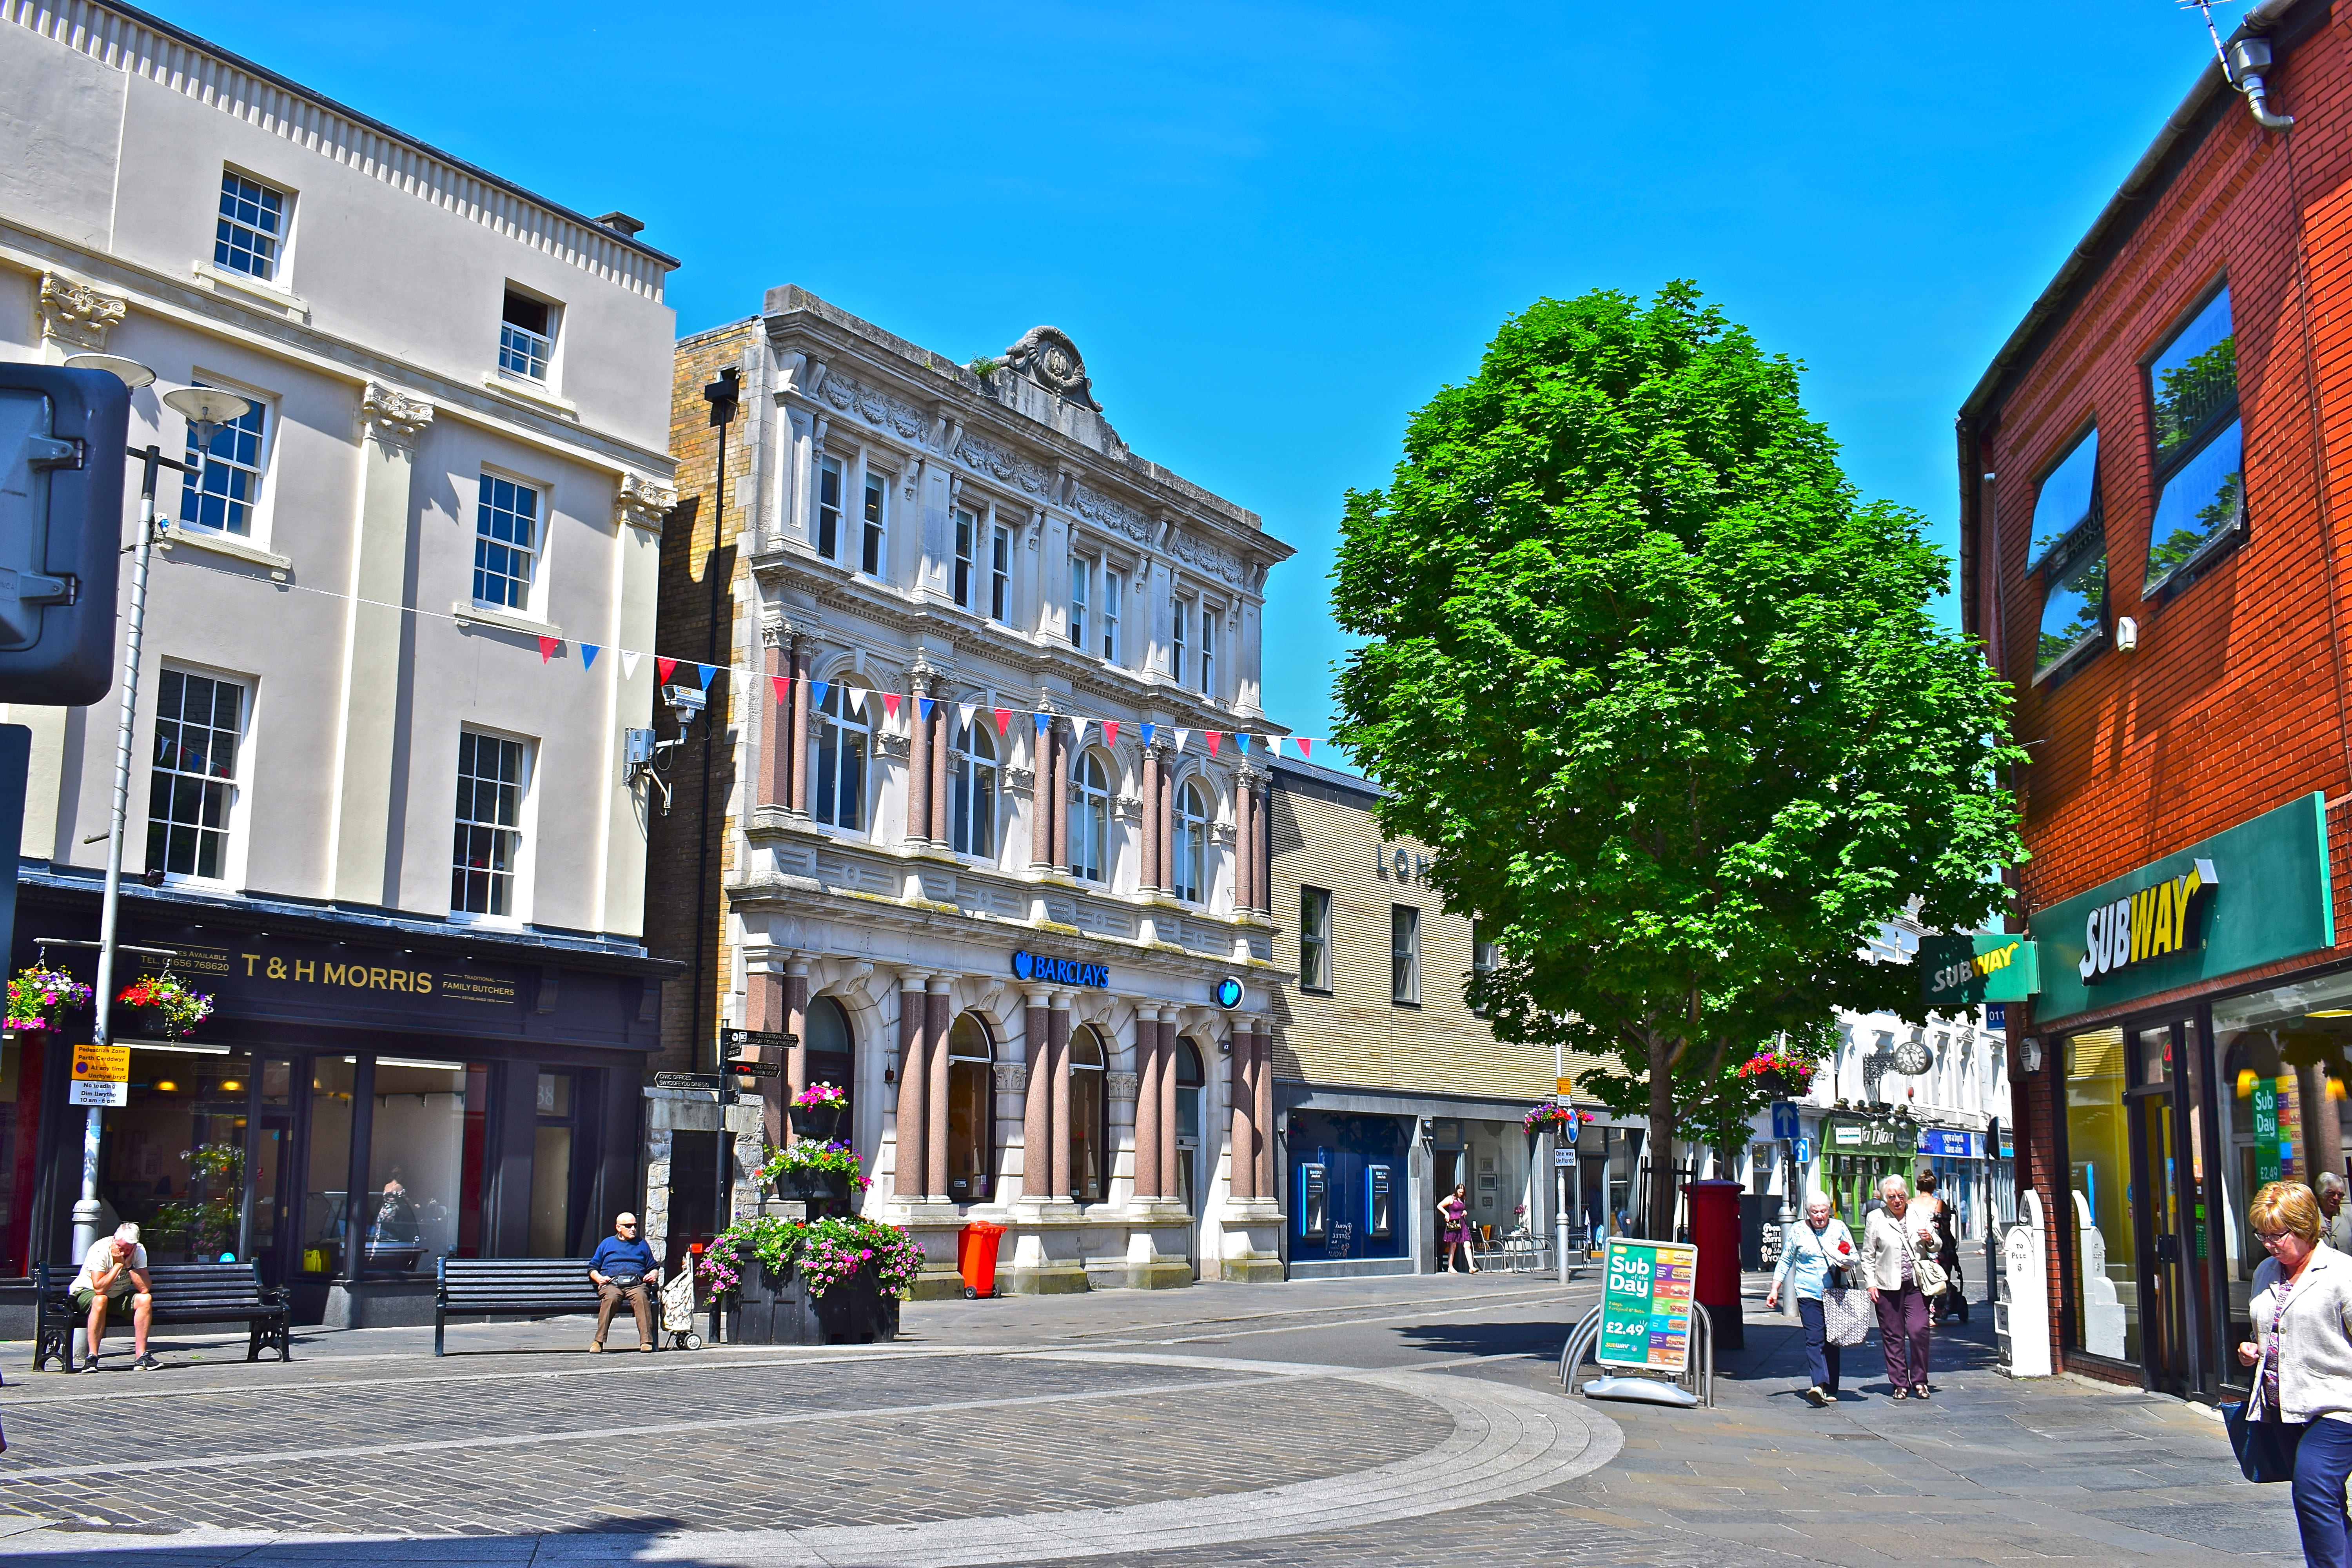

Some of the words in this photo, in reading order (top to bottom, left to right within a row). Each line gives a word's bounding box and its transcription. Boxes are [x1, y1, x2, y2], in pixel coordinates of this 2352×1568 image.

[1376, 844, 1441, 882] LON
[2078, 858, 2213, 986] SUBWAY
[141, 955, 160, 964] TEL.
[162, 958, 191, 967] 01656
[194, 960, 229, 971] 768620
[189, 951, 227, 961] AVAILABLE
[241, 953, 260, 976] T
[267, 956, 287, 980] &
[295, 959, 315, 982] H
[323, 962, 433, 993] MORRIS
[1036, 956, 1109, 988] BARCLAYS
[1931, 941, 2019, 993] SUBWAY
[443, 982, 471, 991] FAMILY
[473, 985, 514, 995] BUTCHERS
[537, 1085, 554, 1105] 38
[2255, 1090, 2273, 1111] Sub
[1862, 1126, 1871, 1142] ia
[2256, 1114, 2275, 1137] Day
[2261, 1166, 2277, 1180] £2.49
[1763, 1223, 1781, 1232] Prou
[1610, 1255, 1650, 1275] Sub
[1610, 1273, 1648, 1298] Day
[1606, 1321, 1644, 1336] £2.49
